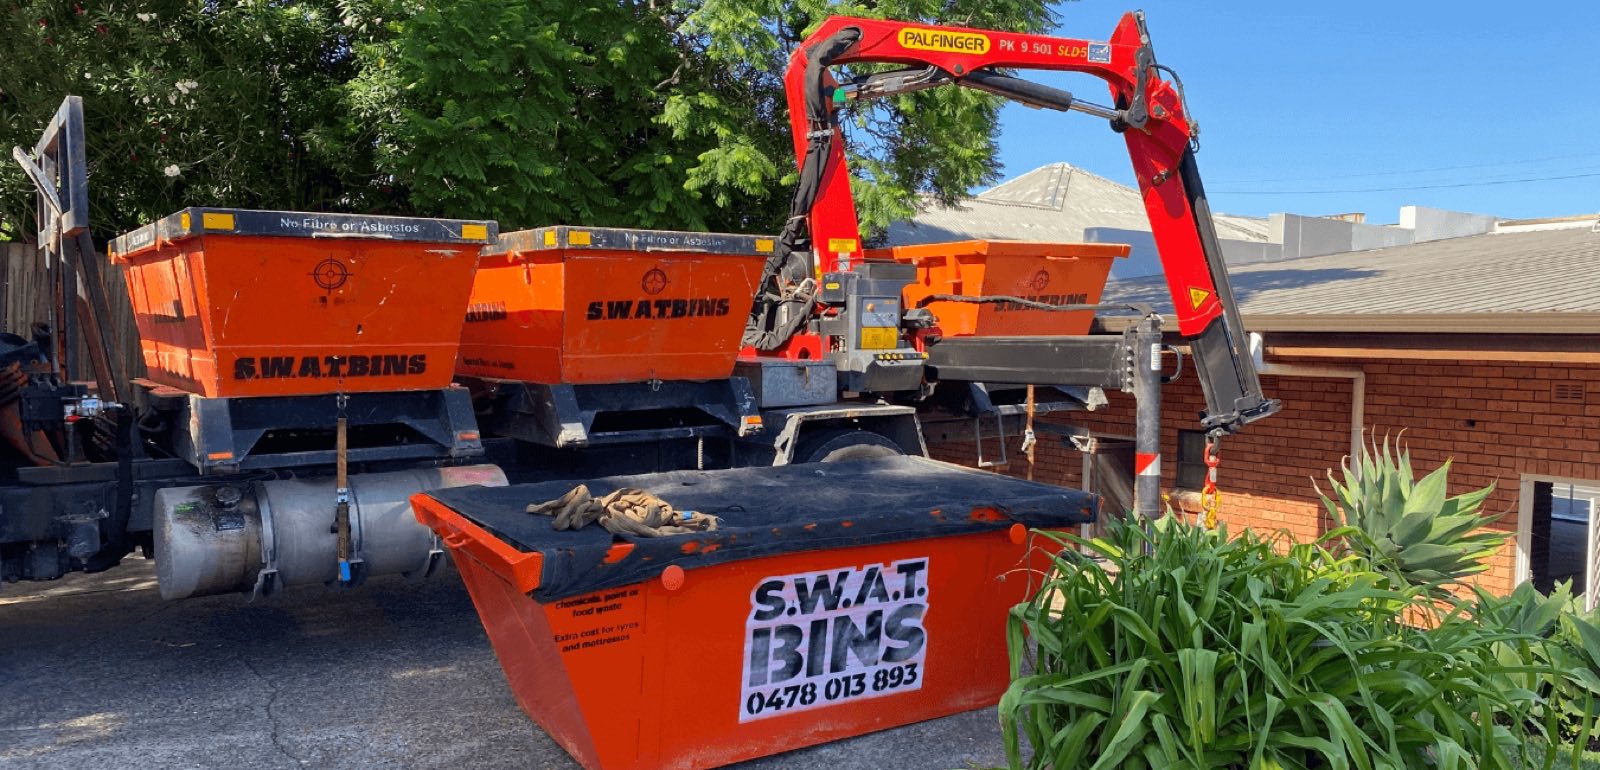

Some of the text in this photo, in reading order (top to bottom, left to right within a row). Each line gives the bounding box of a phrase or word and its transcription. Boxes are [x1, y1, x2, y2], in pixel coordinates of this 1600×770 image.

[903, 31, 985, 51] PALFINGER
[1000, 39, 1015, 51] PK
[1021, 43, 1052, 55] 9.501
[1057, 45, 1087, 58] SLD5
[280, 217, 298, 228] No
[341, 222, 355, 231] or
[361, 220, 420, 233] Asbestos
[669, 236, 679, 245] or
[629, 589, 640, 597] or
[753, 561, 926, 621] S.W.A.T.
[572, 602, 622, 618] food waste
[554, 621, 639, 643] Extra cost for tyres
[562, 634, 630, 653] and mattresses
[749, 603, 925, 688] BINS
[746, 662, 918, 715] 0478 013 893
